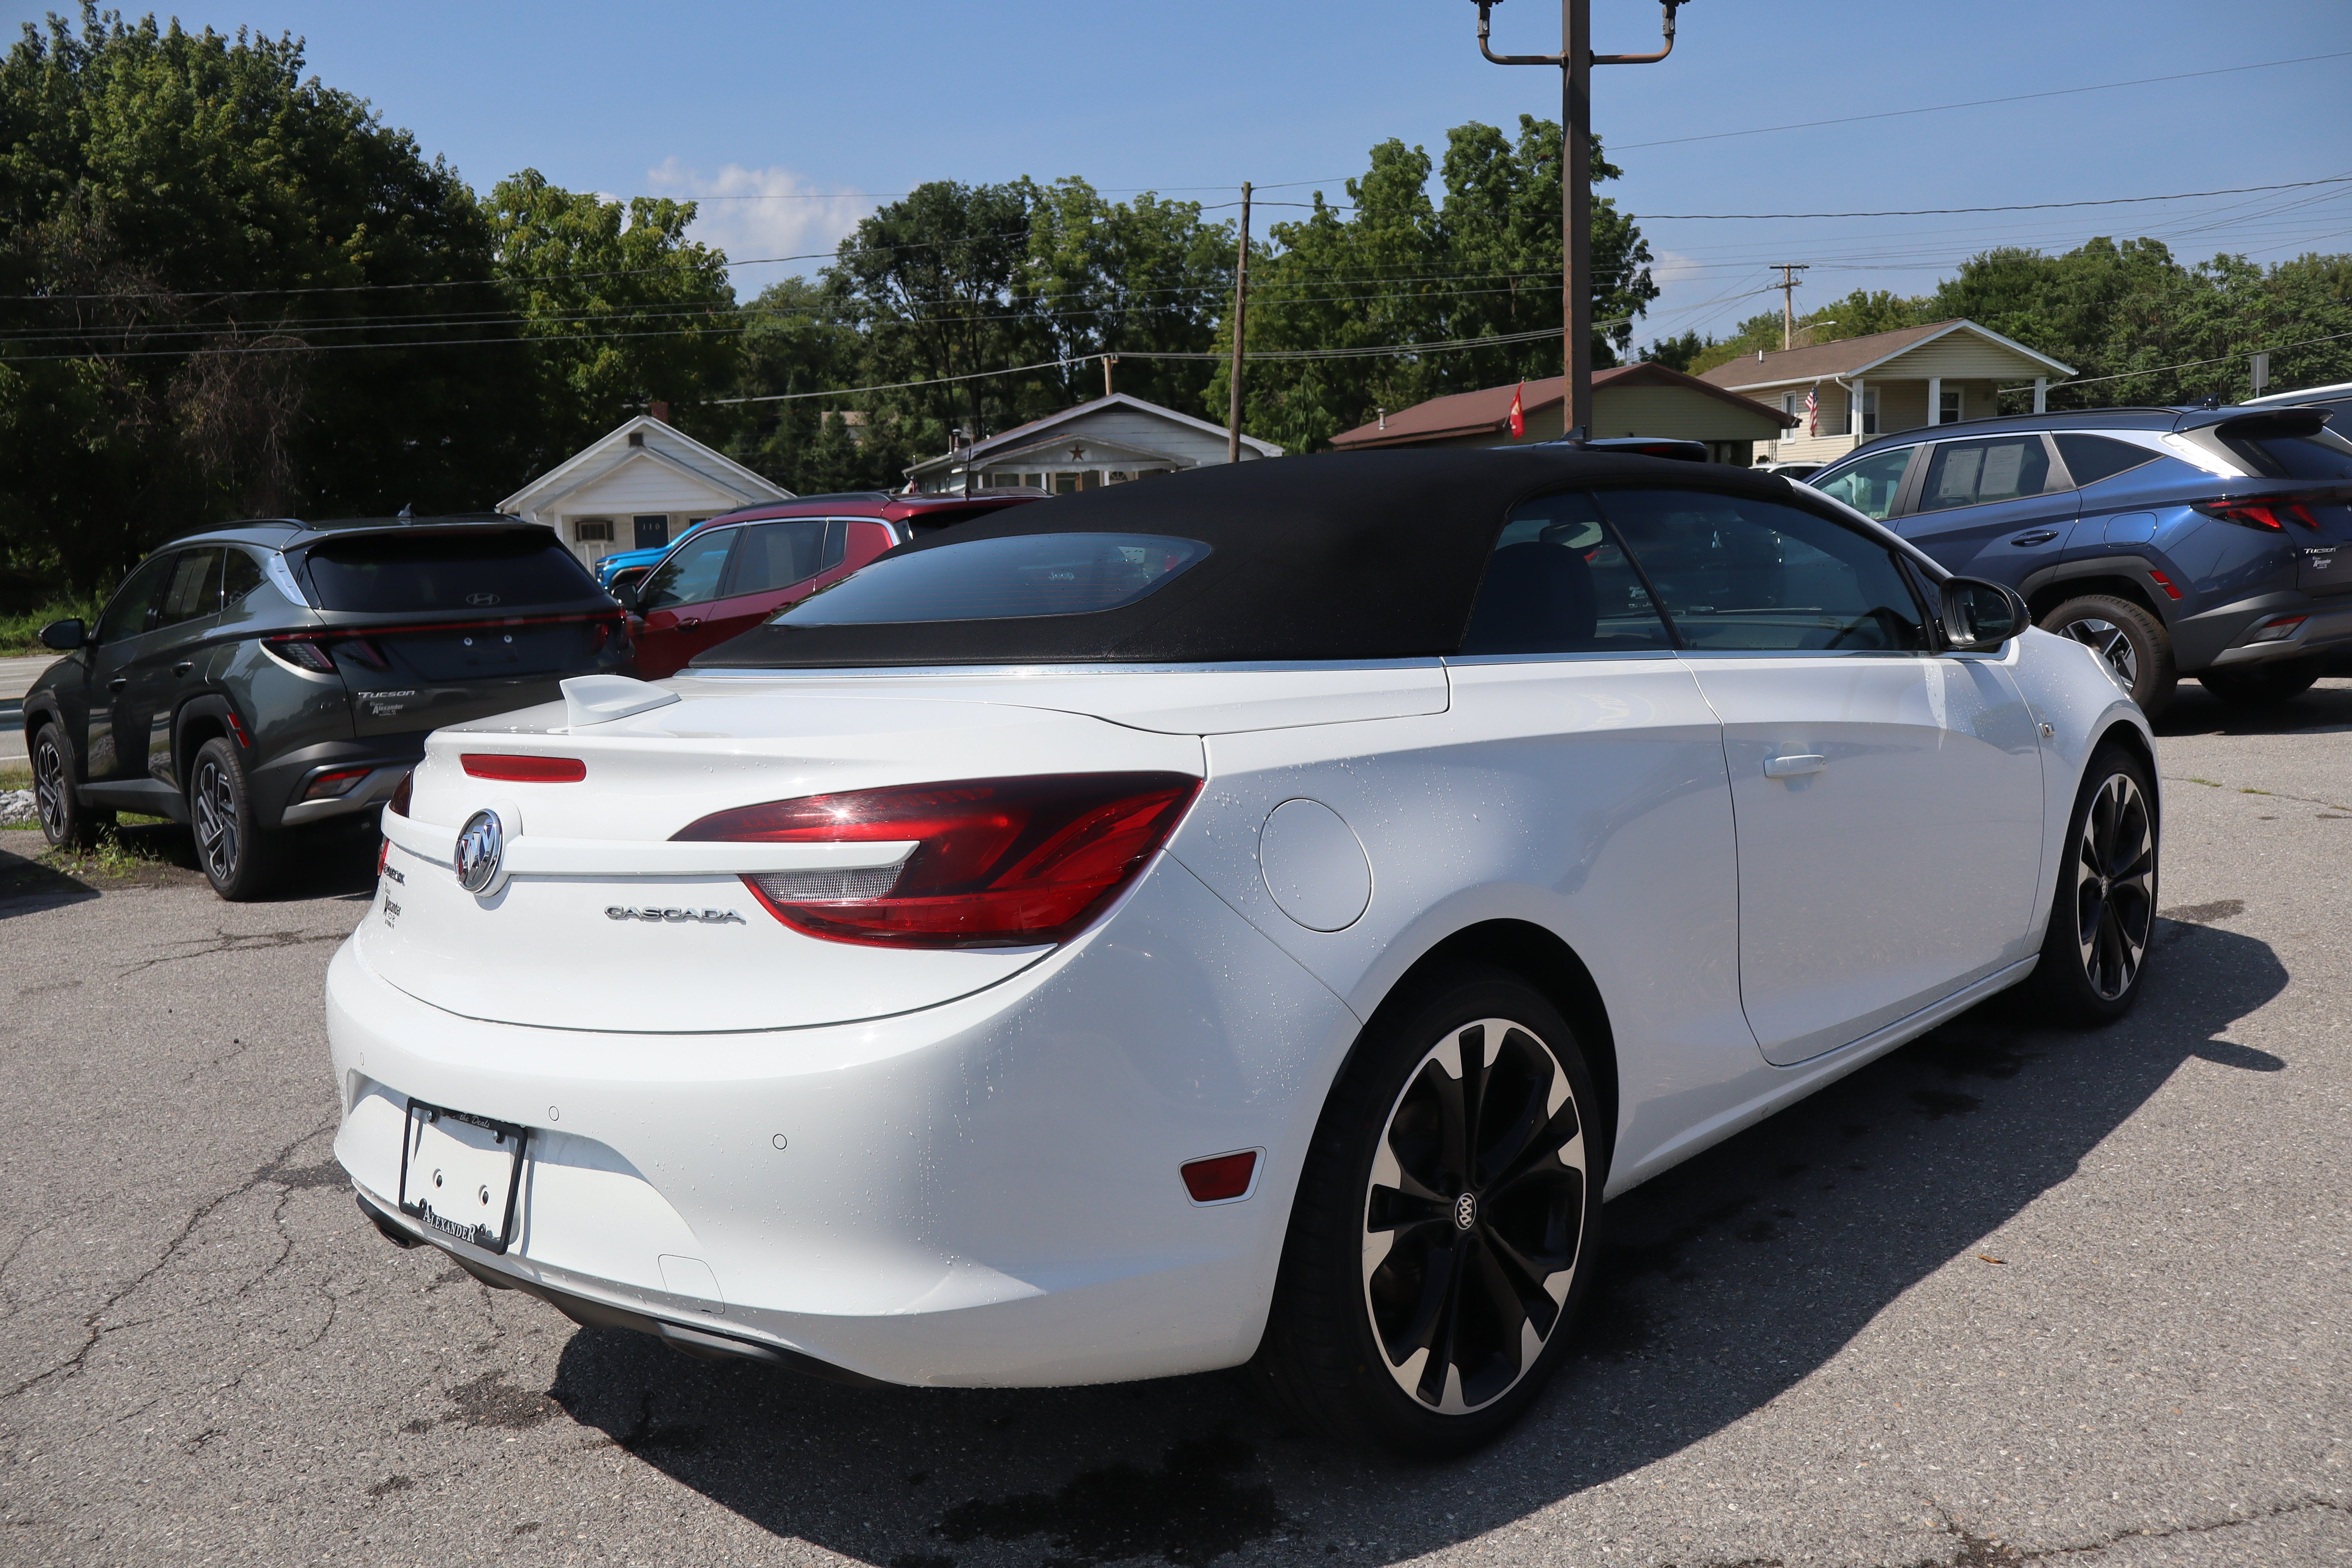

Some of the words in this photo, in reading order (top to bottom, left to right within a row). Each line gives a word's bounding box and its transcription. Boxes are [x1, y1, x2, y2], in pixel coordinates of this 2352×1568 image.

[359, 690, 416, 699] TUCSON
[372, 704, 404, 715] Alexander
[383, 895, 401, 917] Alexander
[604, 906, 746, 925] CASCADA
[459, 1114, 470, 1122] the
[472, 1115, 490, 1128] Deals
[423, 1205, 475, 1244] ALEXANDER
